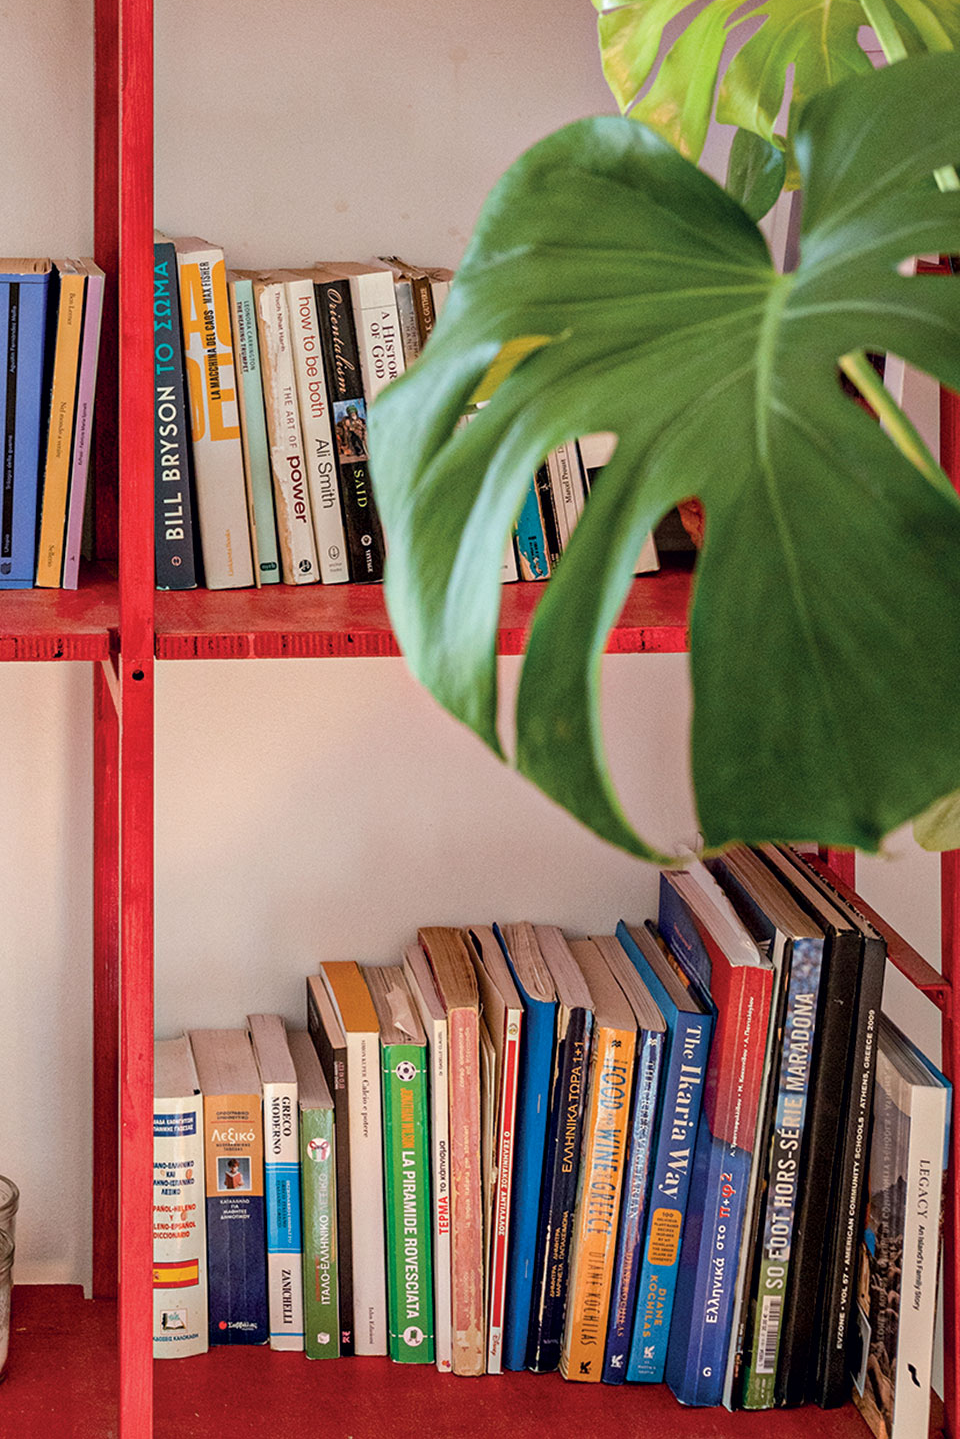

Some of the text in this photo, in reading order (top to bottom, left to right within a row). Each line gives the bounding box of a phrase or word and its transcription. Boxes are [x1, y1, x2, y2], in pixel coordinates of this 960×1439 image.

[67, 307, 75, 325] Lerner
[200, 262, 212, 304] MAX FISHER
[153, 261, 175, 375] ΤΟ ΣΩΜΑ
[326, 288, 355, 393] Orientalism
[370, 322, 387, 379] OF GOD
[205, 310, 221, 400] LA MACCHINA DEL CAOS
[298, 296, 326, 418] how to be both
[283, 386, 297, 449] THE ART OF
[157, 386, 185, 540] BILL BRYSON
[285, 455, 308, 524] power
[314, 439, 336, 508] Ali Smith
[353, 470, 368, 507] SAID
[682, 1025, 703, 1059] The
[211, 1127, 256, 1144] Λεξικό
[271, 1096, 282, 1154] MODERNO
[281, 1096, 292, 1137] GRECO
[400, 1087, 415, 1149] JONATHAN WILSON
[561, 1041, 583, 1173] ΕΛΛΗΝΙΚΑ ΤΩΡΑ 1+1
[671, 1064, 701, 1141] Ikaria
[587, 1065, 627, 1235] FOOD WINE GREECE
[659, 1148, 691, 1200] Way
[765, 994, 815, 1290] SO FOOT HORS-SÉRIE MARADONA
[438, 1141, 449, 1235] ΤΕΡΜΑ το κάπνισμα
[318, 1173, 330, 1305] ΙΤΑΛΟ-ΕΛΛΗΝΙΚΟ ΛΕΞΙΚΟ
[402, 1151, 420, 1319] LA PIRAMIDE ROVESCIATA
[706, 1173, 737, 1324] Ελληνικά στο π+φ 2
[912, 1158, 931, 1312] LEGACY An Island's Family Story
[282, 1269, 293, 1324] ZANICHELLI
[579, 1251, 604, 1346] DIANE KOCHILAS
[642, 1275, 658, 1338] KOCHILAS
[653, 1288, 667, 1326] DIANE
